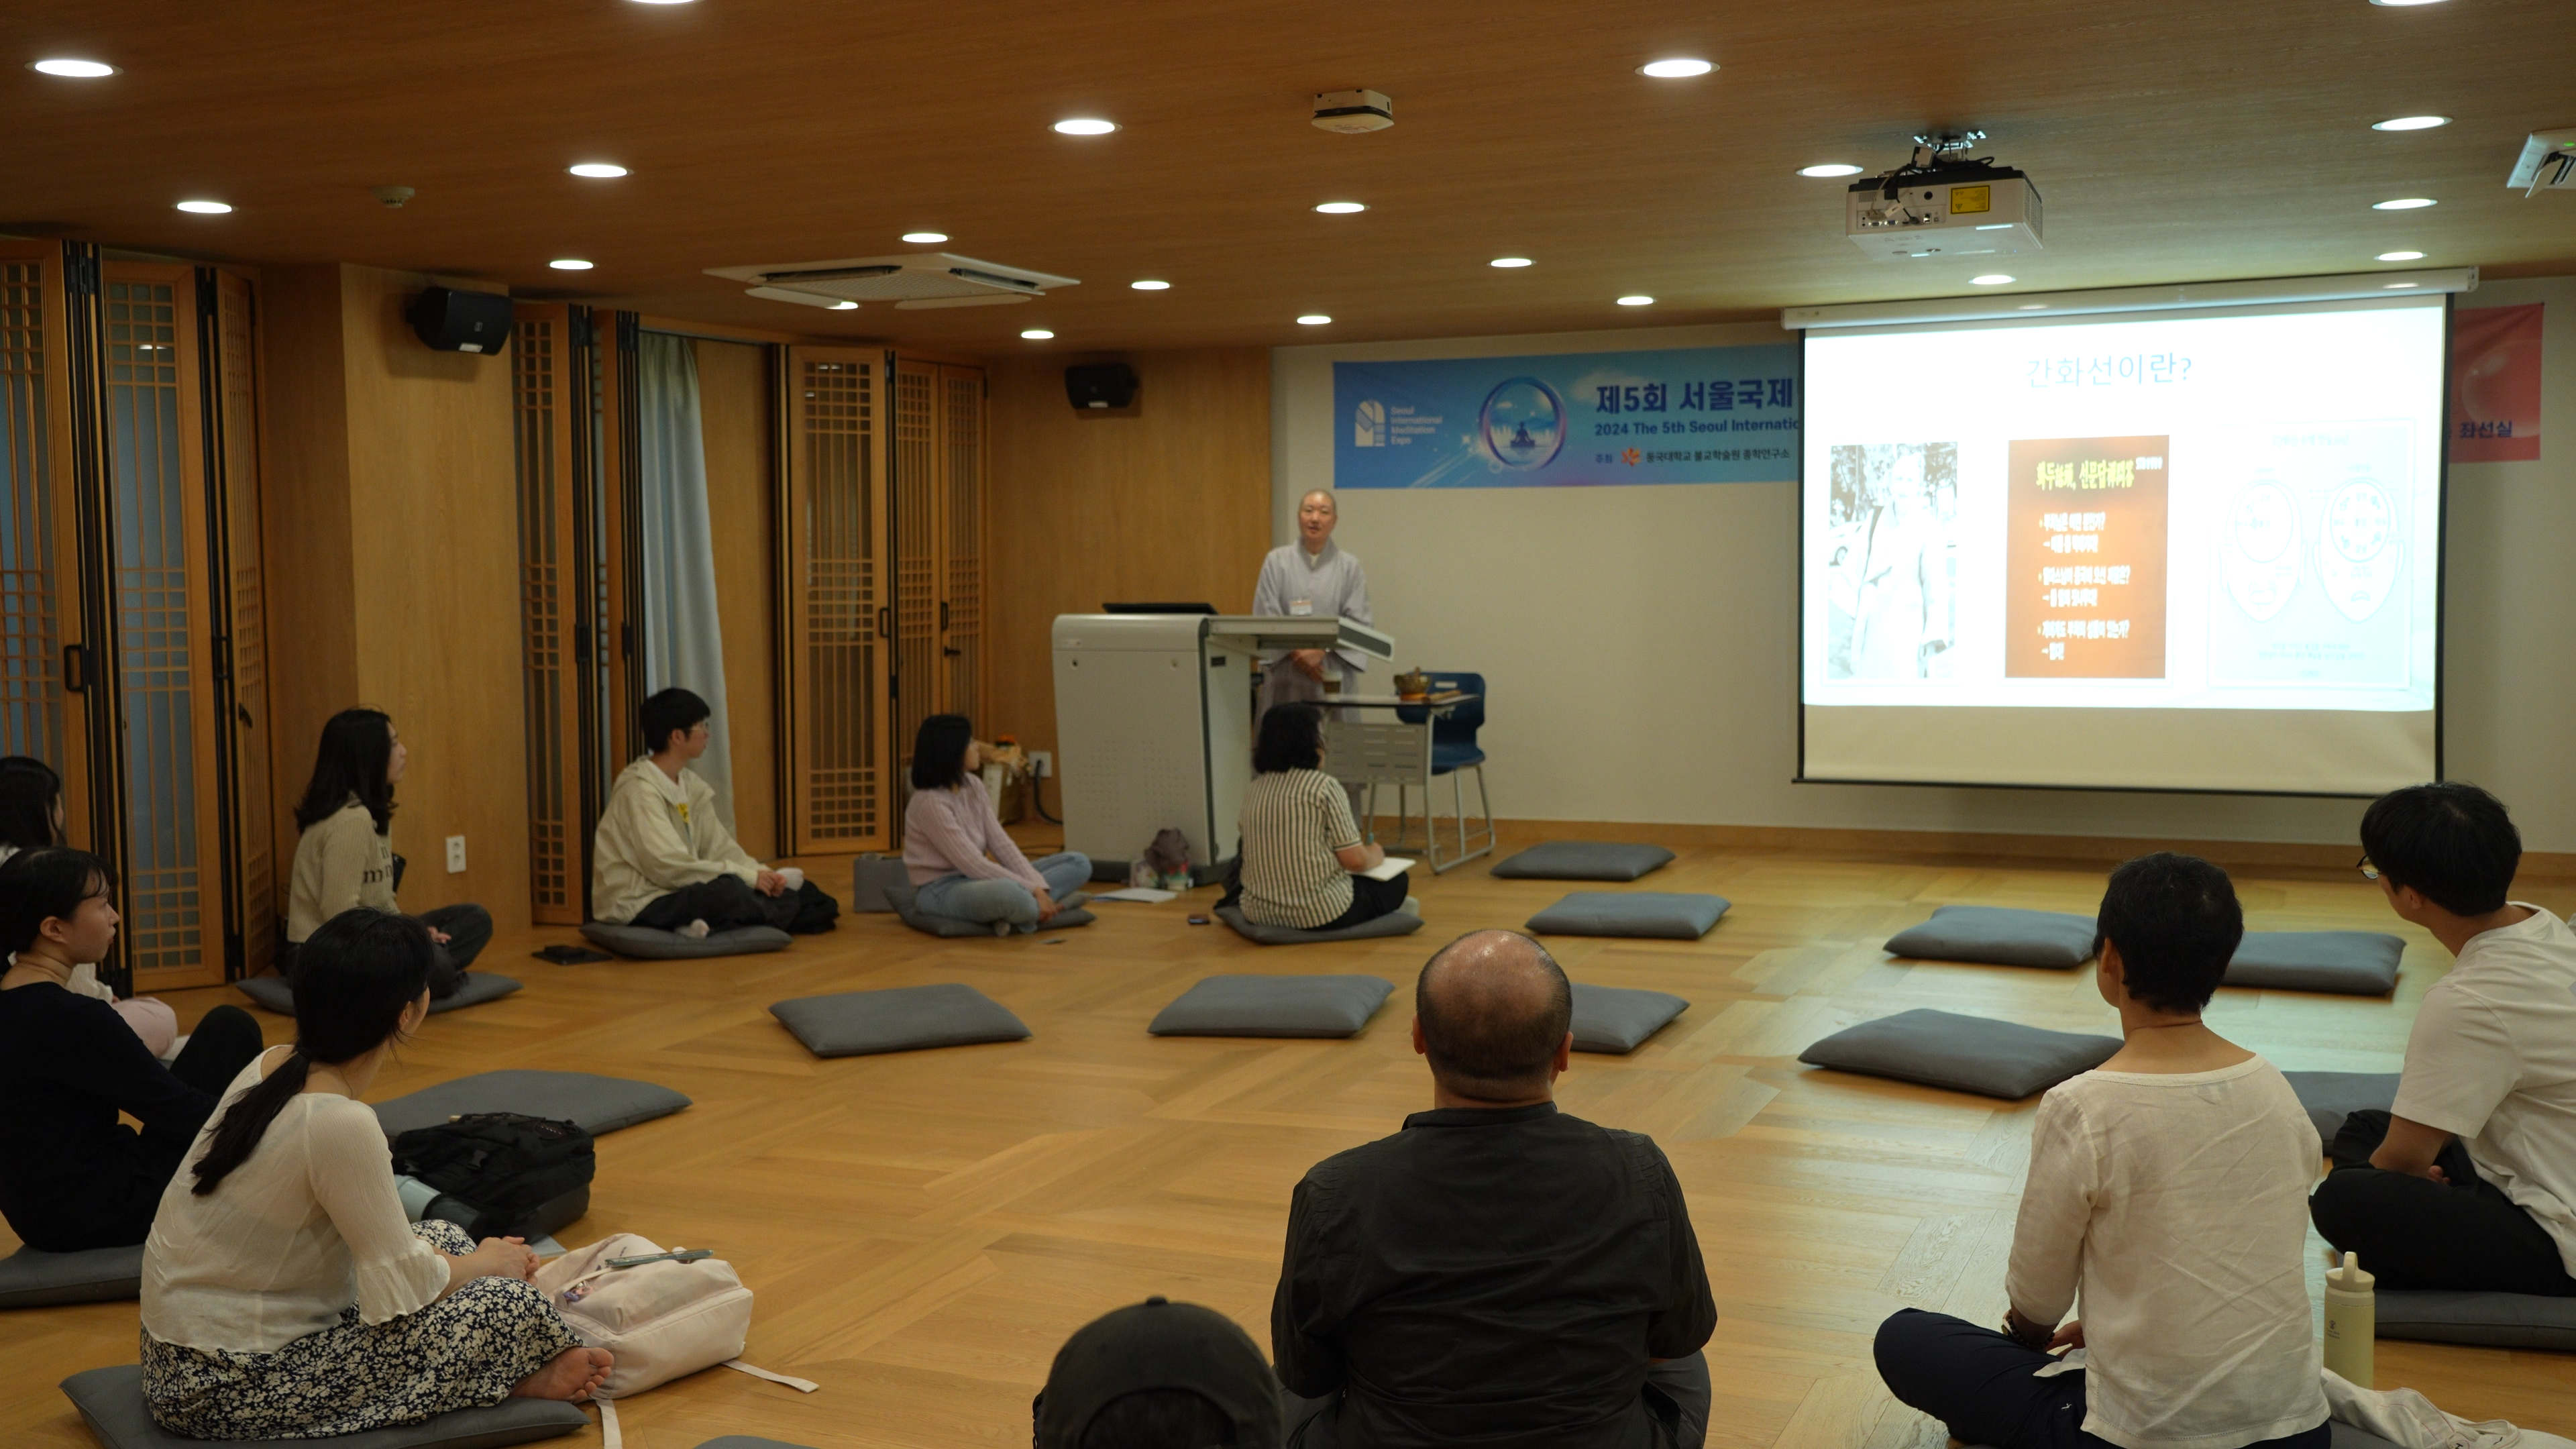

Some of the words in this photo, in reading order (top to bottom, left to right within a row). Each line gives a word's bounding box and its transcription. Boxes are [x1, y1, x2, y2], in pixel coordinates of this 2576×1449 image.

[2027, 352, 2192, 388] 간화선이란?
[1596, 383, 1667, 414] 제5회
[1678, 378, 1793, 412] 서울국제
[1595, 423, 1629, 436] 2024
[1633, 422, 1658, 435] The
[1662, 421, 1685, 434] 5th
[1690, 419, 1727, 433] Seoul
[2460, 421, 2512, 438] 좌선실
